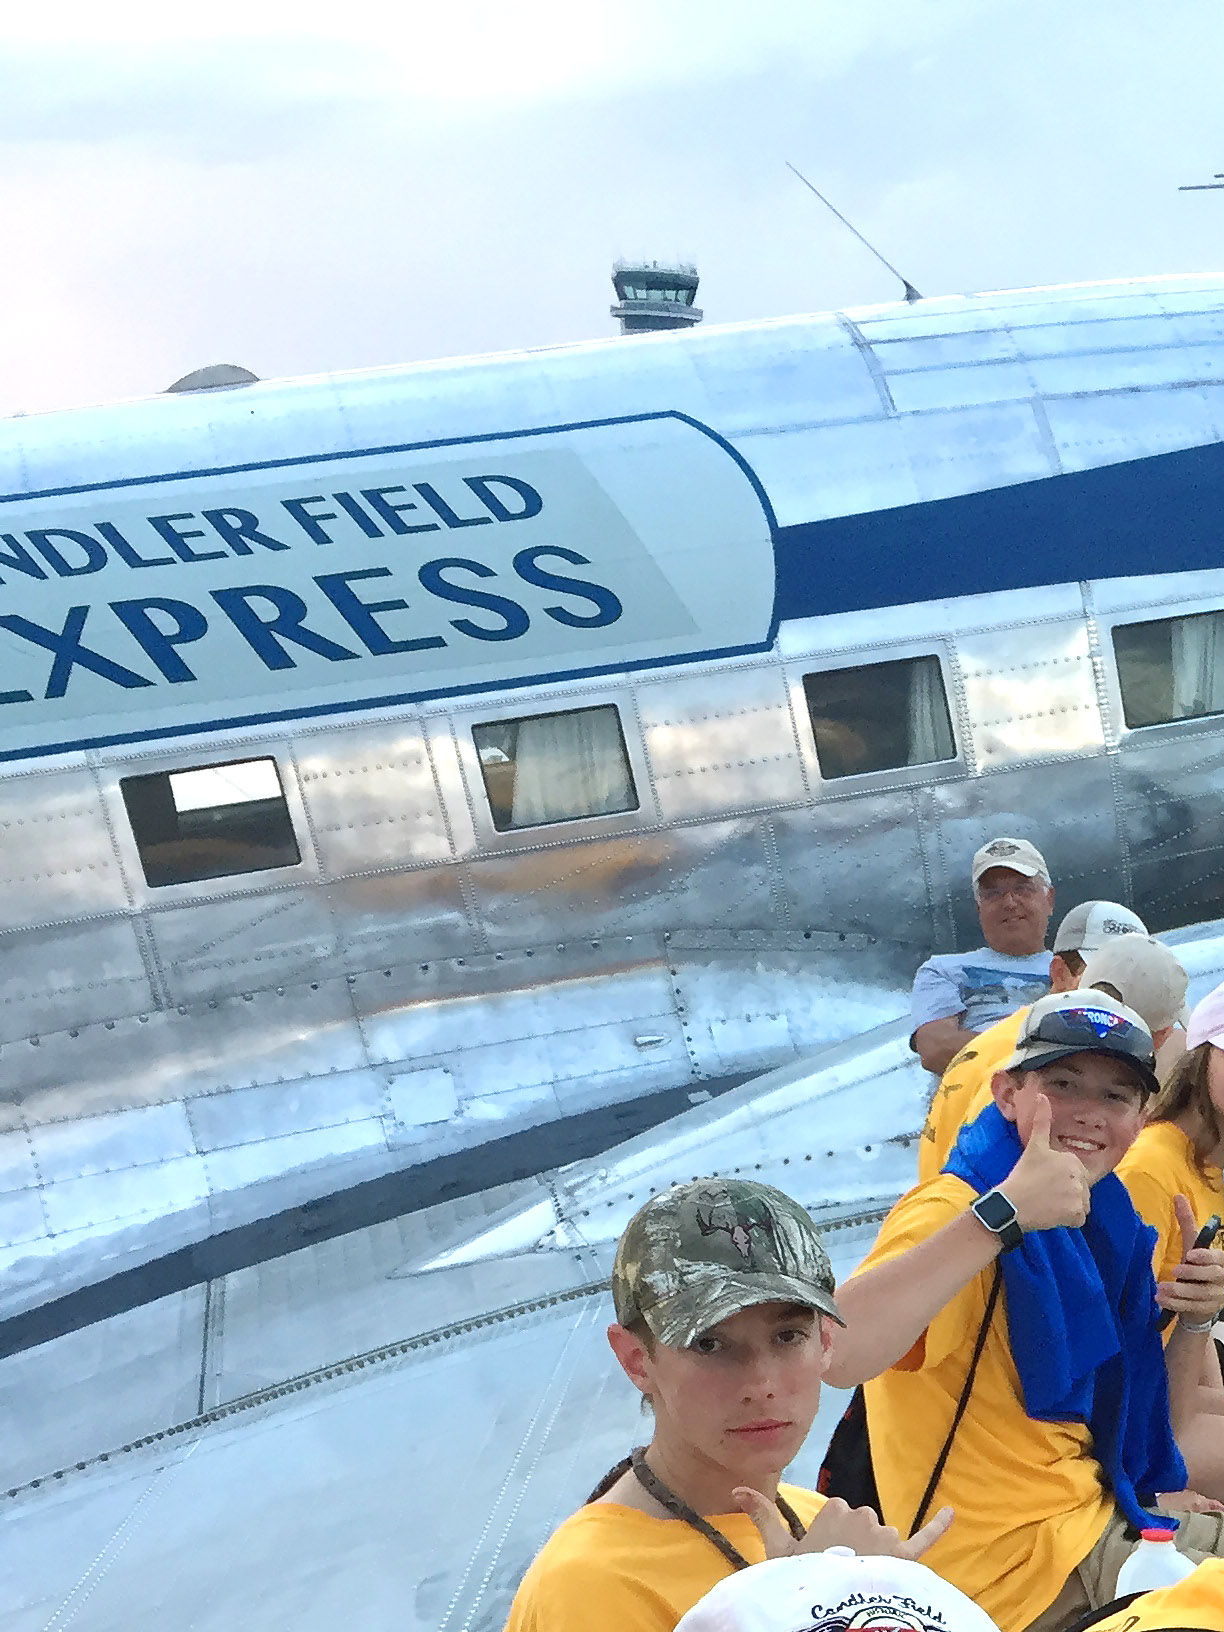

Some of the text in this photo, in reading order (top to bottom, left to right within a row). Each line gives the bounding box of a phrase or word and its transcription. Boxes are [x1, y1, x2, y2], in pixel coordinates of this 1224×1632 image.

[279, 474, 544, 545] FIELD
[811, 1592, 947, 1625] Candler Field
